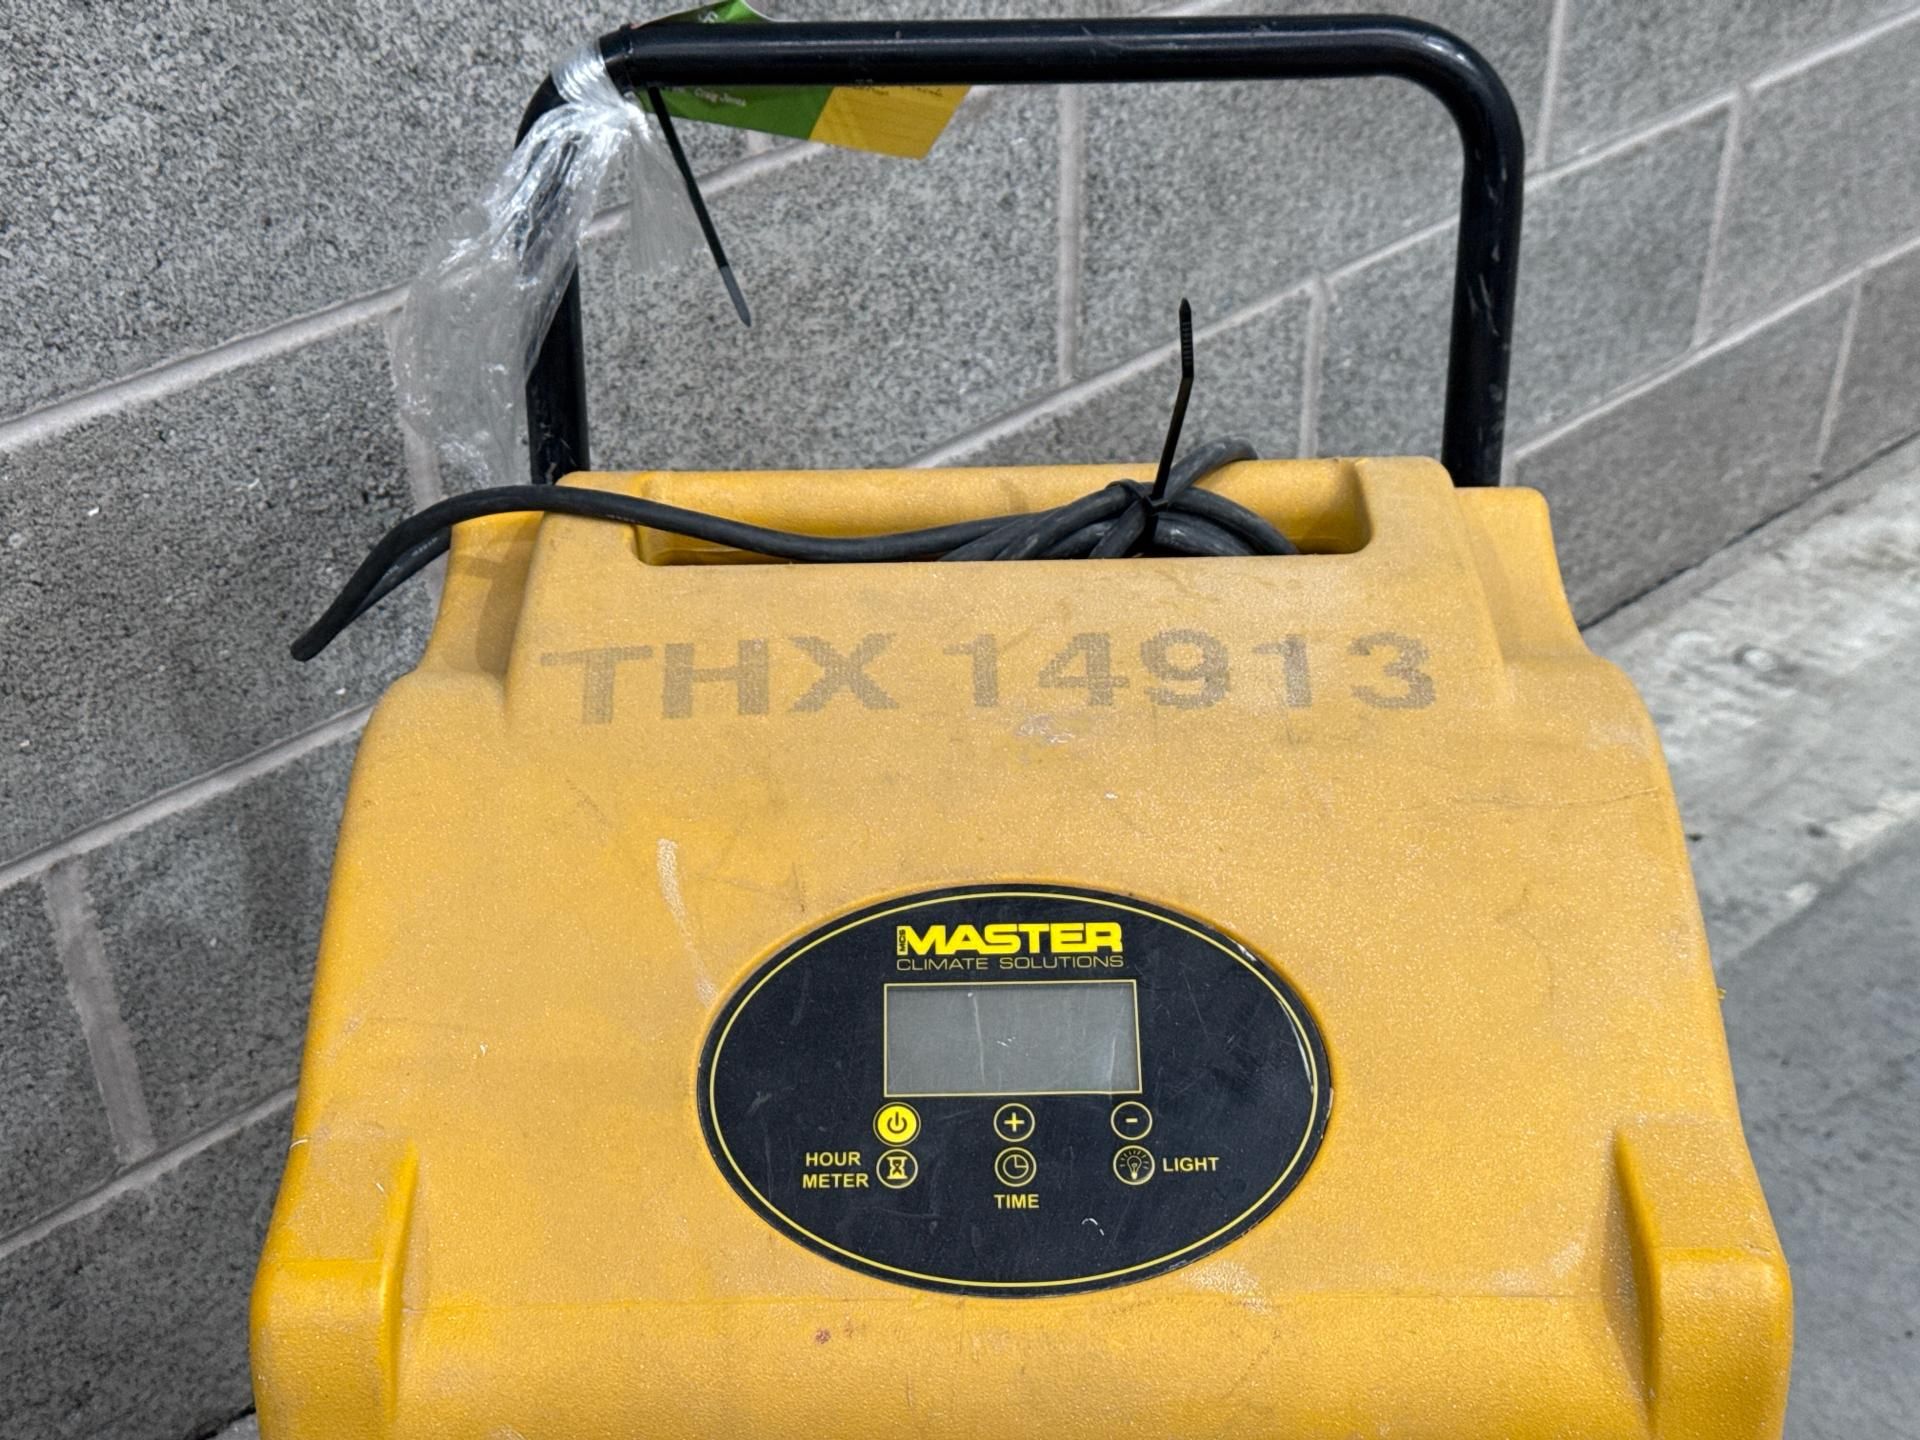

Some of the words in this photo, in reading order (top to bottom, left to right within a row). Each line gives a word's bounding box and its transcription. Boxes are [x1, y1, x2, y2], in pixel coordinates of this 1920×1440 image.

[540, 633, 900, 724] THX
[942, 628, 1437, 709] 14913
[896, 922, 1124, 955] MASTER
[898, 928, 908, 953] MCS
[896, 958, 989, 971] CLIMATE
[1000, 955, 1124, 970] SOLUTIONS
[805, 1151, 862, 1167] HOUR
[1162, 1156, 1220, 1173] LIGHT
[802, 1172, 870, 1189] METER
[993, 1193, 1040, 1209] TIME
